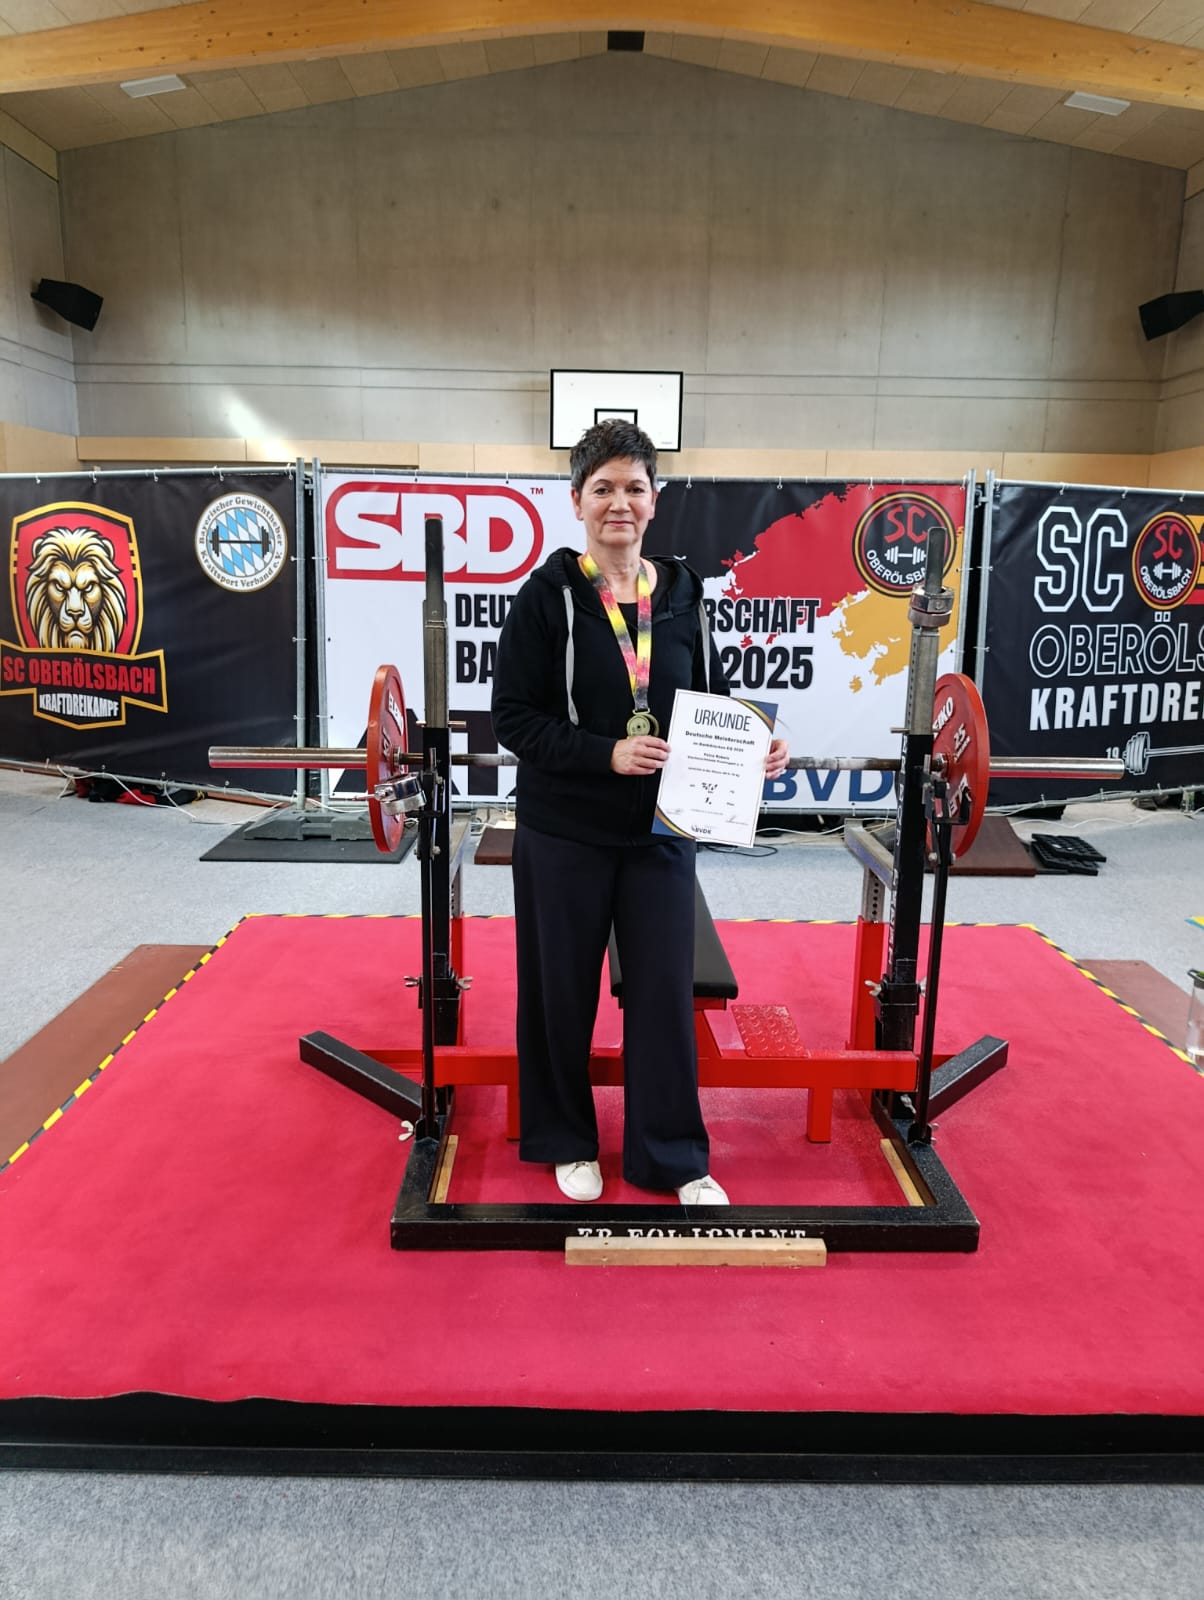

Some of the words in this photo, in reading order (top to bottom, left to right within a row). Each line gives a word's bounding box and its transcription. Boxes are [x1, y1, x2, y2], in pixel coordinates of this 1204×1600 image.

[530, 487, 544, 495] TM
[199, 500, 233, 544] Bayerischer
[335, 491, 534, 574] SBD
[885, 505, 928, 543] SC
[1034, 506, 1128, 612] SC
[1152, 523, 1183, 560] SC
[201, 550, 238, 587] Kraftsport
[240, 569, 274, 587] Verband
[866, 549, 927, 584] OBERÖLSBA
[1140, 565, 1193, 599] OBERÖLSBACH
[455, 593, 518, 628] DEU
[702, 598, 820, 633] RSCHAFT
[3, 656, 25, 683] SC
[29, 657, 156, 694] OBERÖLSBACH
[456, 640, 499, 684] BA
[720, 646, 814, 690] 2025
[39, 693, 119, 718] KRAFTDREIKAMPF
[694, 708, 752, 732] URKUNDE
[1029, 681, 1204, 731] KRAFTDRE
[685, 730, 713, 740] Deutsche
[714, 735, 755, 746] Meisterschaft
